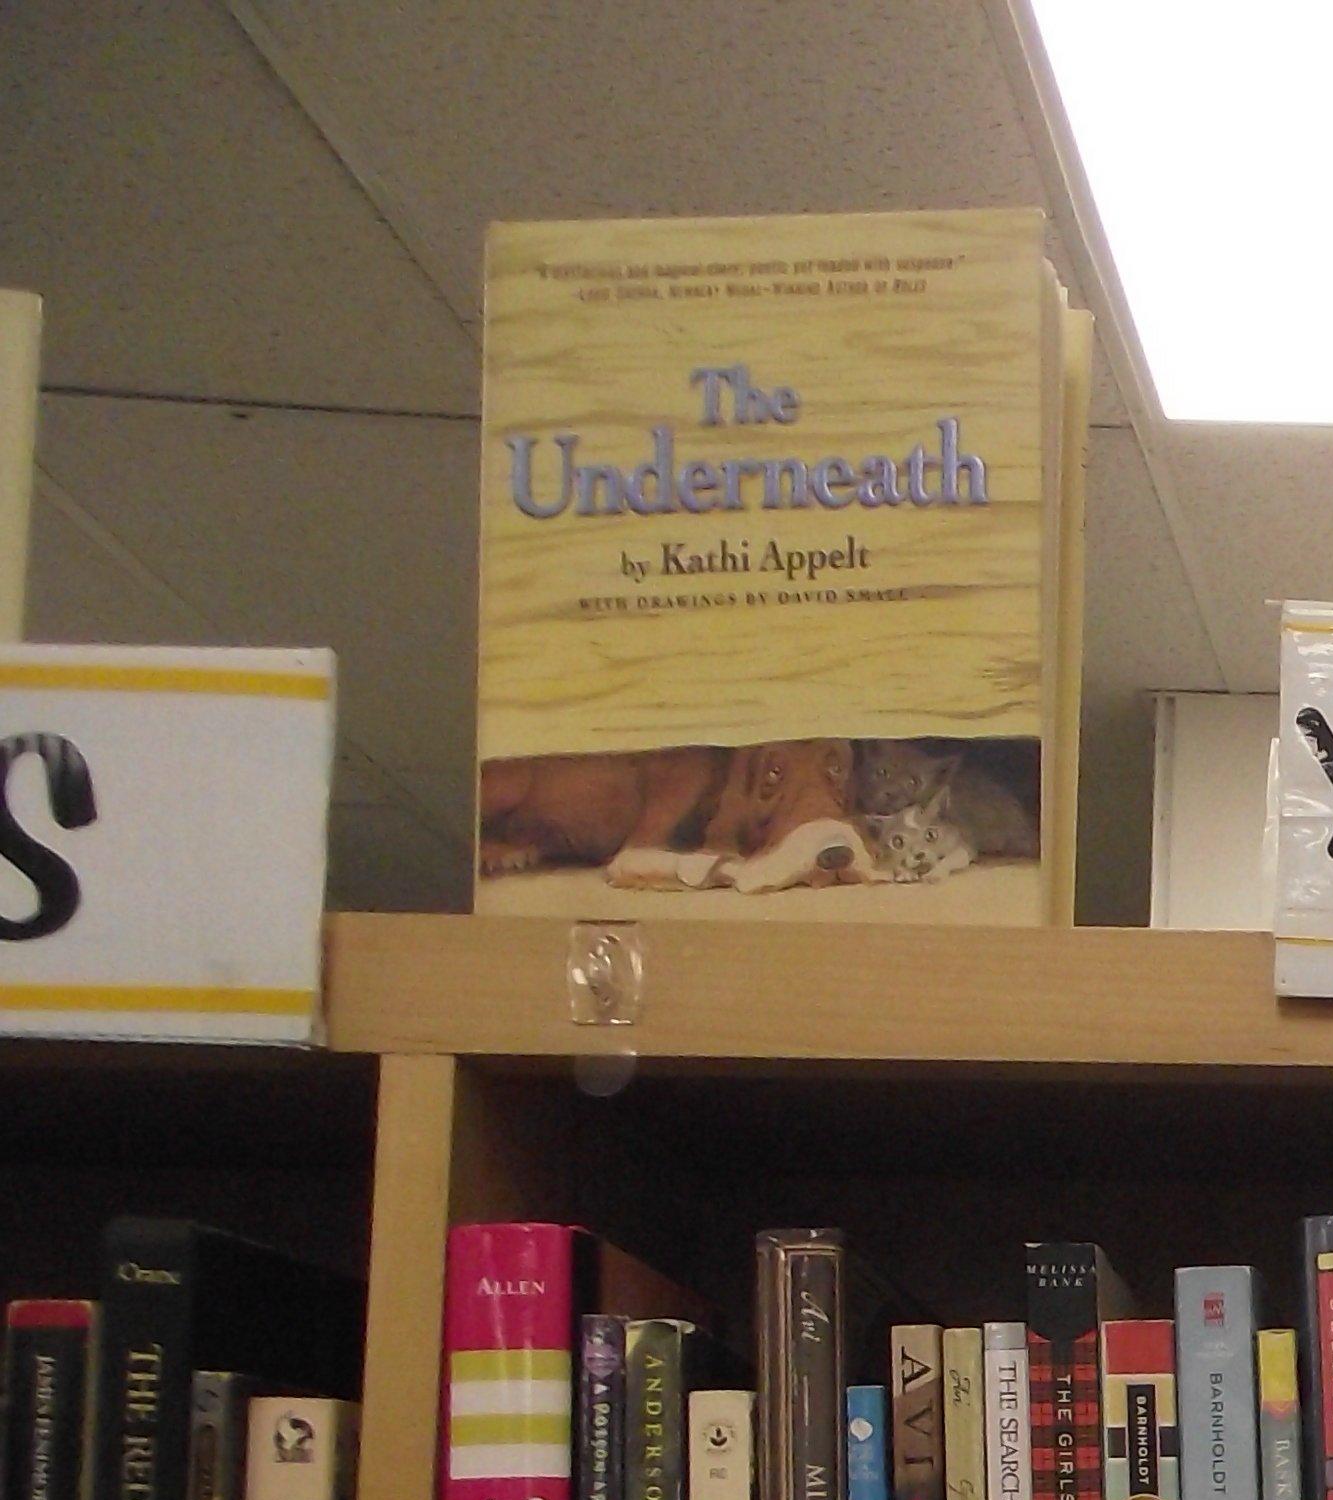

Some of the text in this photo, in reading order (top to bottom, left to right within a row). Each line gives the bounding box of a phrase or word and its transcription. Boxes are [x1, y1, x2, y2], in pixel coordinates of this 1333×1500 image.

[691, 363, 801, 426] The
[504, 415, 988, 519] Underneath
[621, 535, 870, 583] by Kathi Appelt
[579, 596, 628, 612] WITH
[637, 594, 736, 610] DRAWINGS
[746, 592, 767, 607] BY
[777, 589, 838, 605] DAVID
[476, 1277, 545, 1296] ALLEN
[124, 1344, 164, 1423] THE
[1057, 1375, 1072, 1420] THE
[1135, 1396, 1149, 1485] BARNHOLDT
